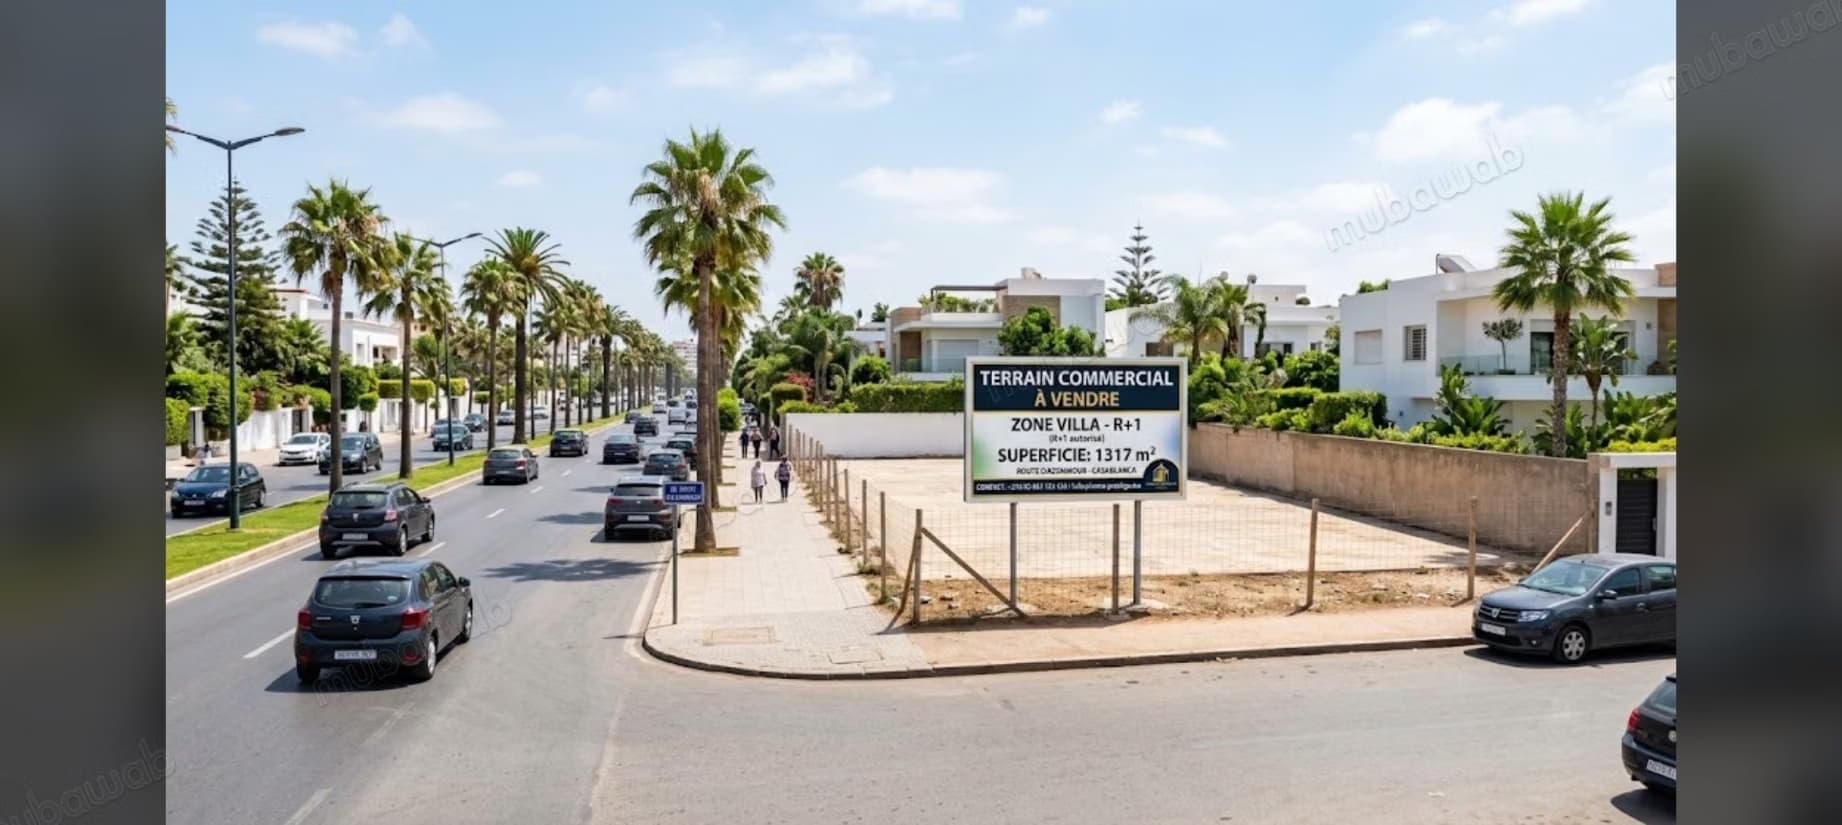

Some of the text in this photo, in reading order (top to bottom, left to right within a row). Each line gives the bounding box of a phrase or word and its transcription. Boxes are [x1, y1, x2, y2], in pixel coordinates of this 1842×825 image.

[979, 370, 1174, 387] TERRAIN COMMERCIAL
[1034, 388, 1120, 407] À VENDRE
[1011, 417, 1053, 432] ZONE
[1057, 417, 1101, 432] VILLA
[1113, 417, 1141, 432] R+1
[998, 447, 1091, 463] SUPERFICIE:
[1096, 447, 1132, 463] 1317
